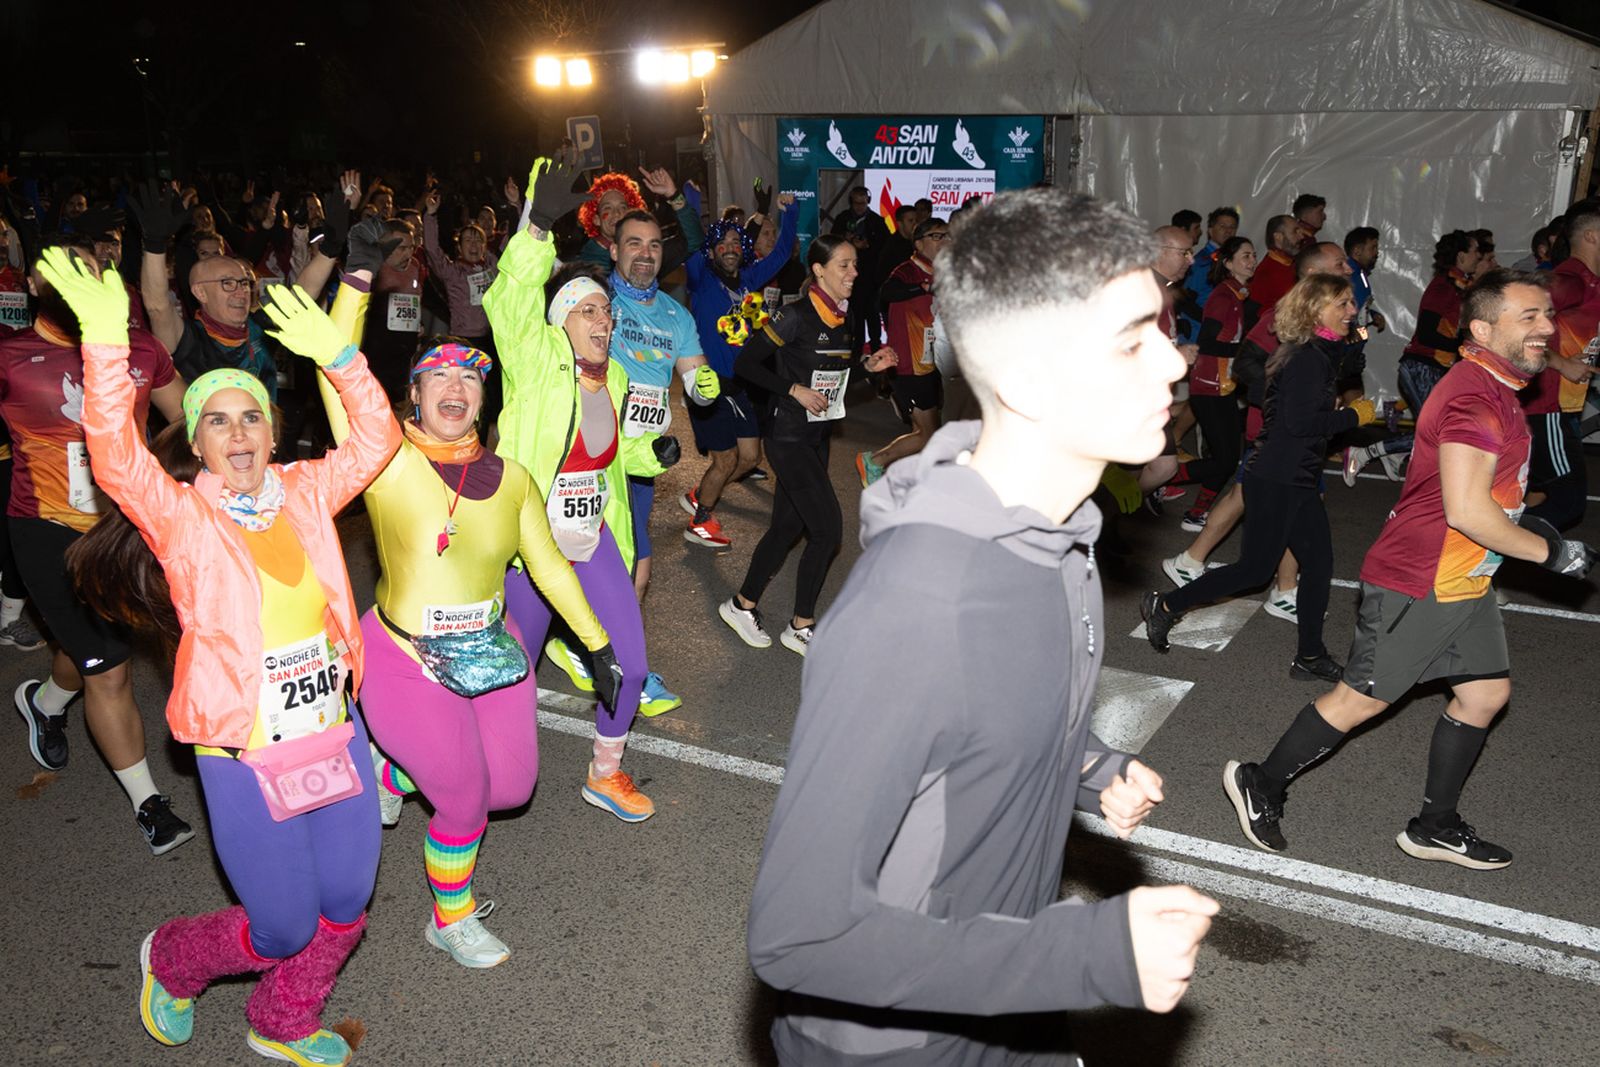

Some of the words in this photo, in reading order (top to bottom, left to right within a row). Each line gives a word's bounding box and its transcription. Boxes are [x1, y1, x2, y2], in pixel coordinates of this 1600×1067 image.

[874, 124, 898, 145] 43
[898, 125, 939, 144] SAN
[835, 147, 847, 160] 43
[869, 141, 935, 165] ANTÓN
[962, 147, 975, 161] 43
[930, 191, 960, 205] SAN
[629, 404, 666, 425] 2020
[564, 494, 602, 518] 5513
[445, 613, 473, 622] NOCHE
[474, 611, 484, 619] DE
[280, 650, 310, 668] NOCHE
[310, 646, 320, 658] DE
[268, 670, 291, 684] SAN
[281, 664, 339, 710] 2546
